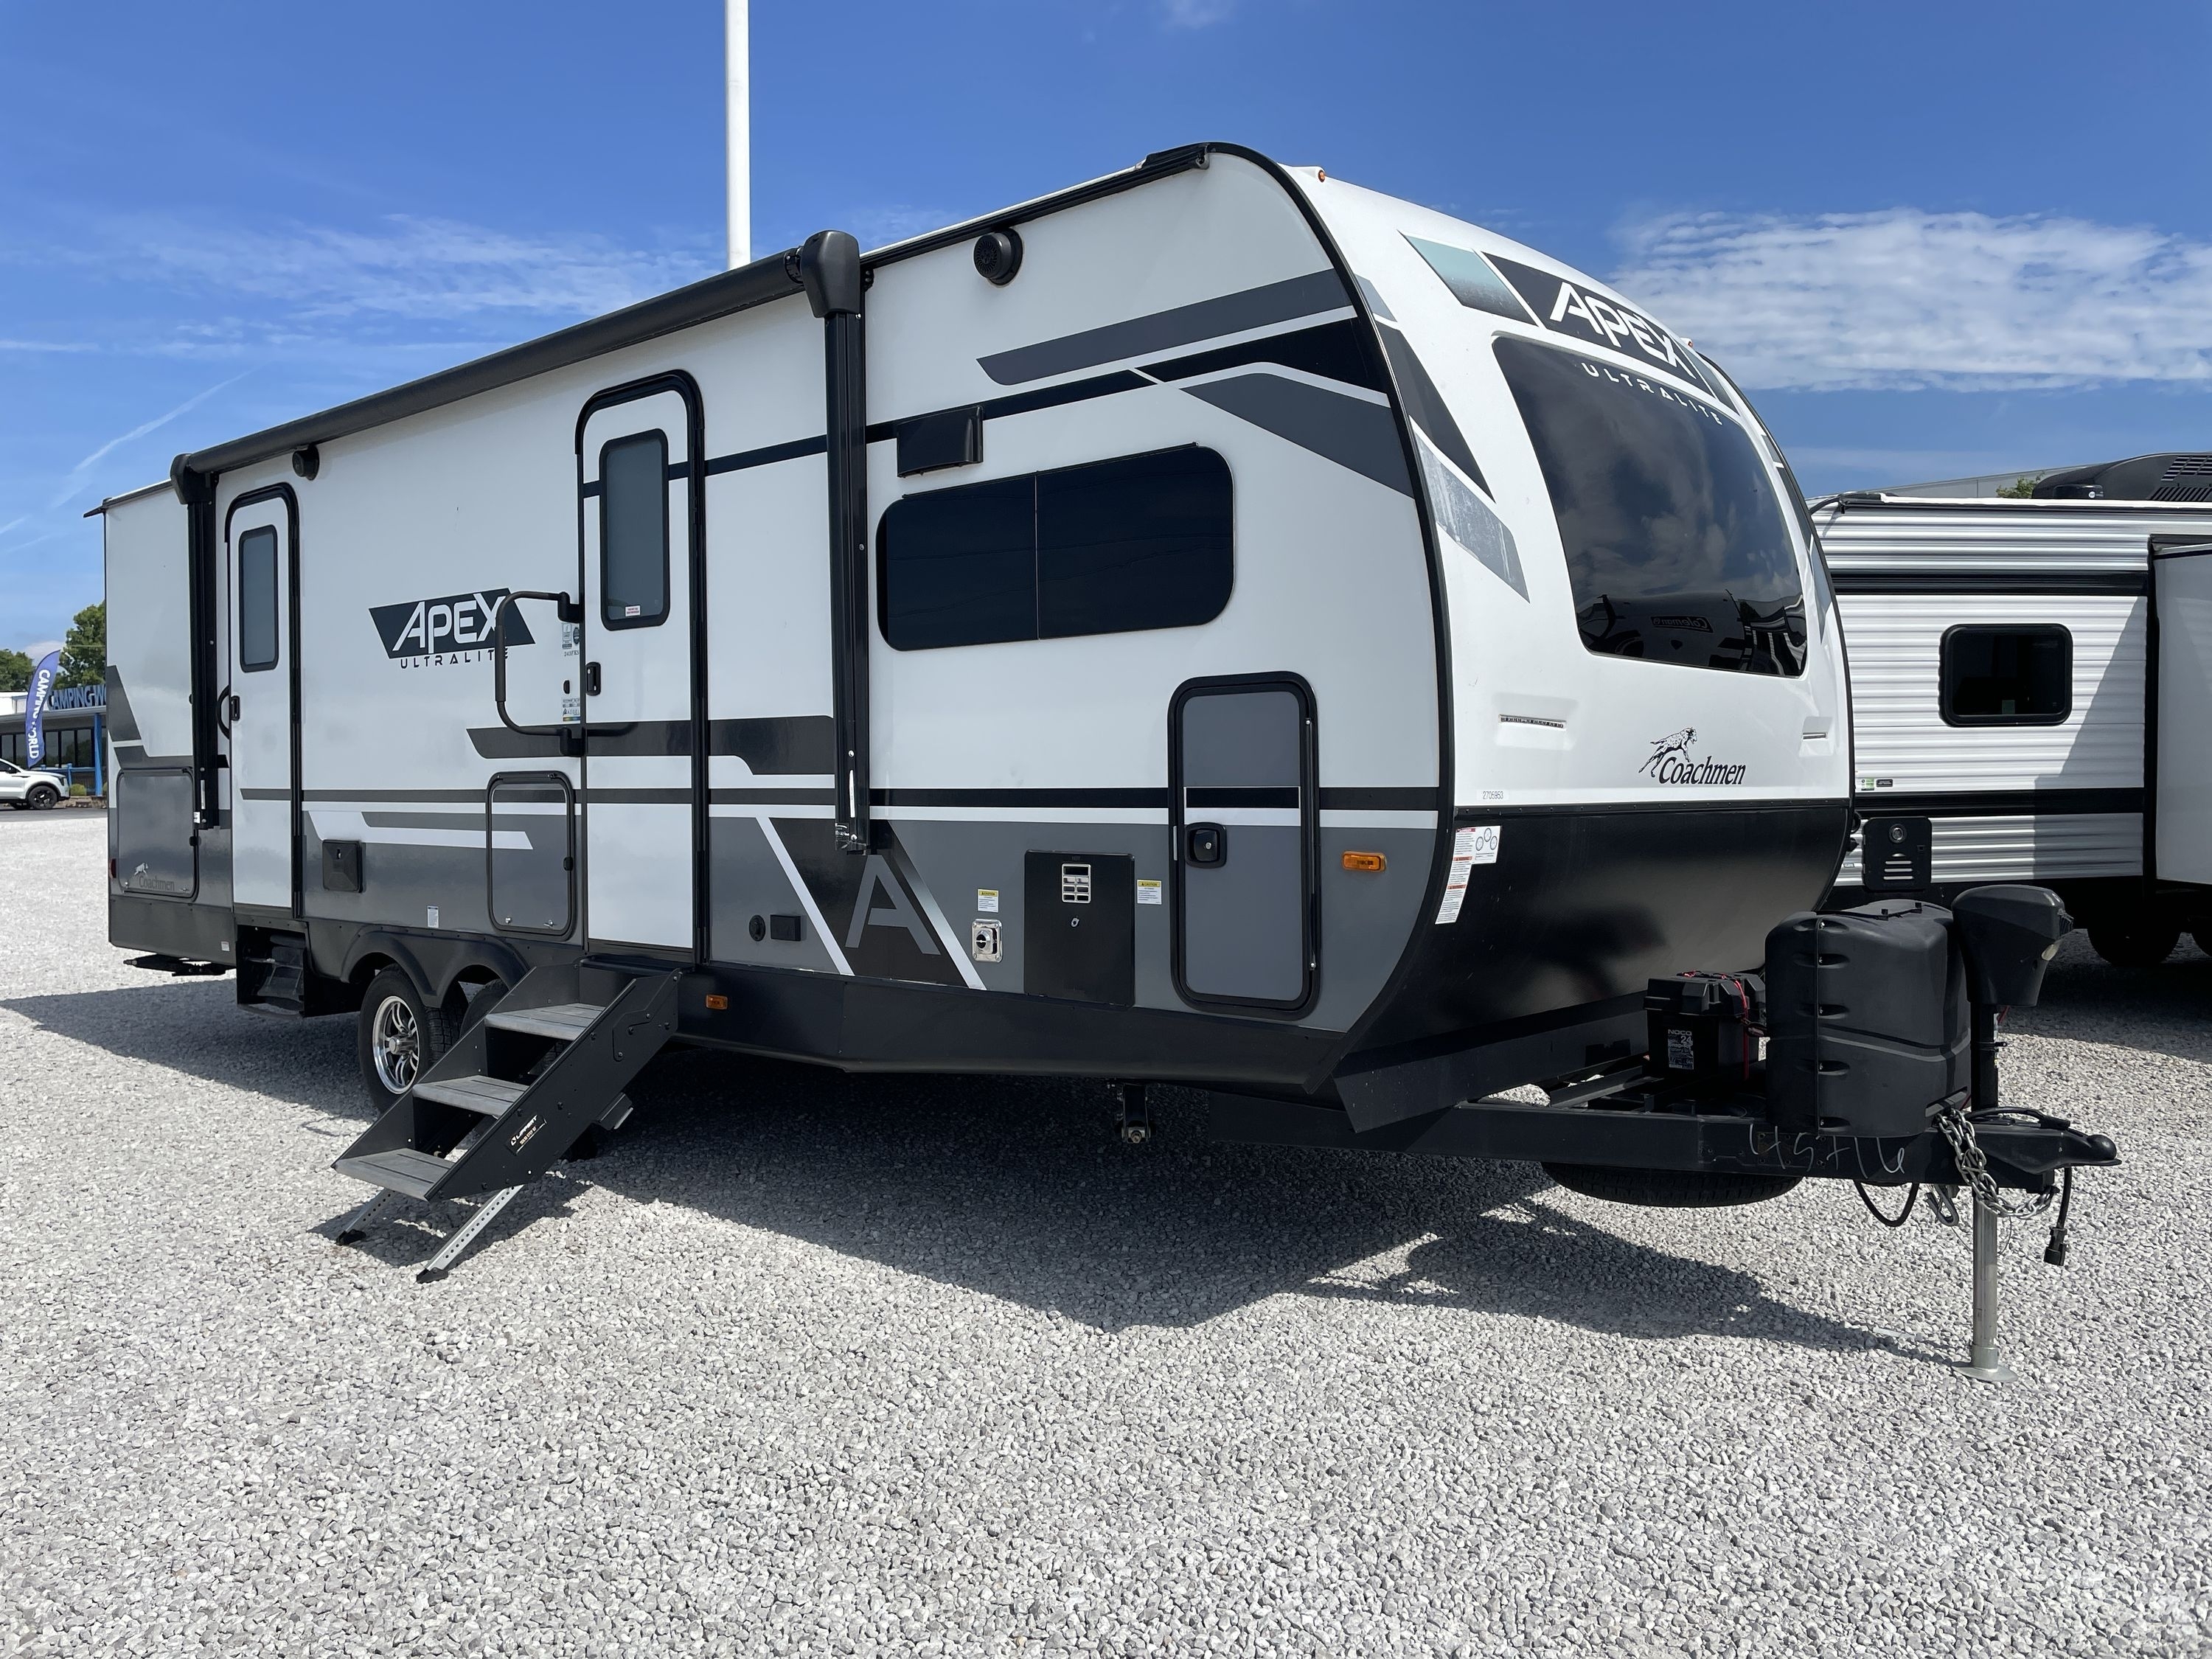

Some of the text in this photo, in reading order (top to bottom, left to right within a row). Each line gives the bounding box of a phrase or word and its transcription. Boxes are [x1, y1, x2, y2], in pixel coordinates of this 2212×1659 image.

[1549, 281, 1697, 380] APEX
[1581, 362, 1724, 425] ULTRALITE
[392, 592, 507, 655] APEX
[1658, 755, 1747, 785] Coachmen
[139, 875, 175, 891] Coachmen
